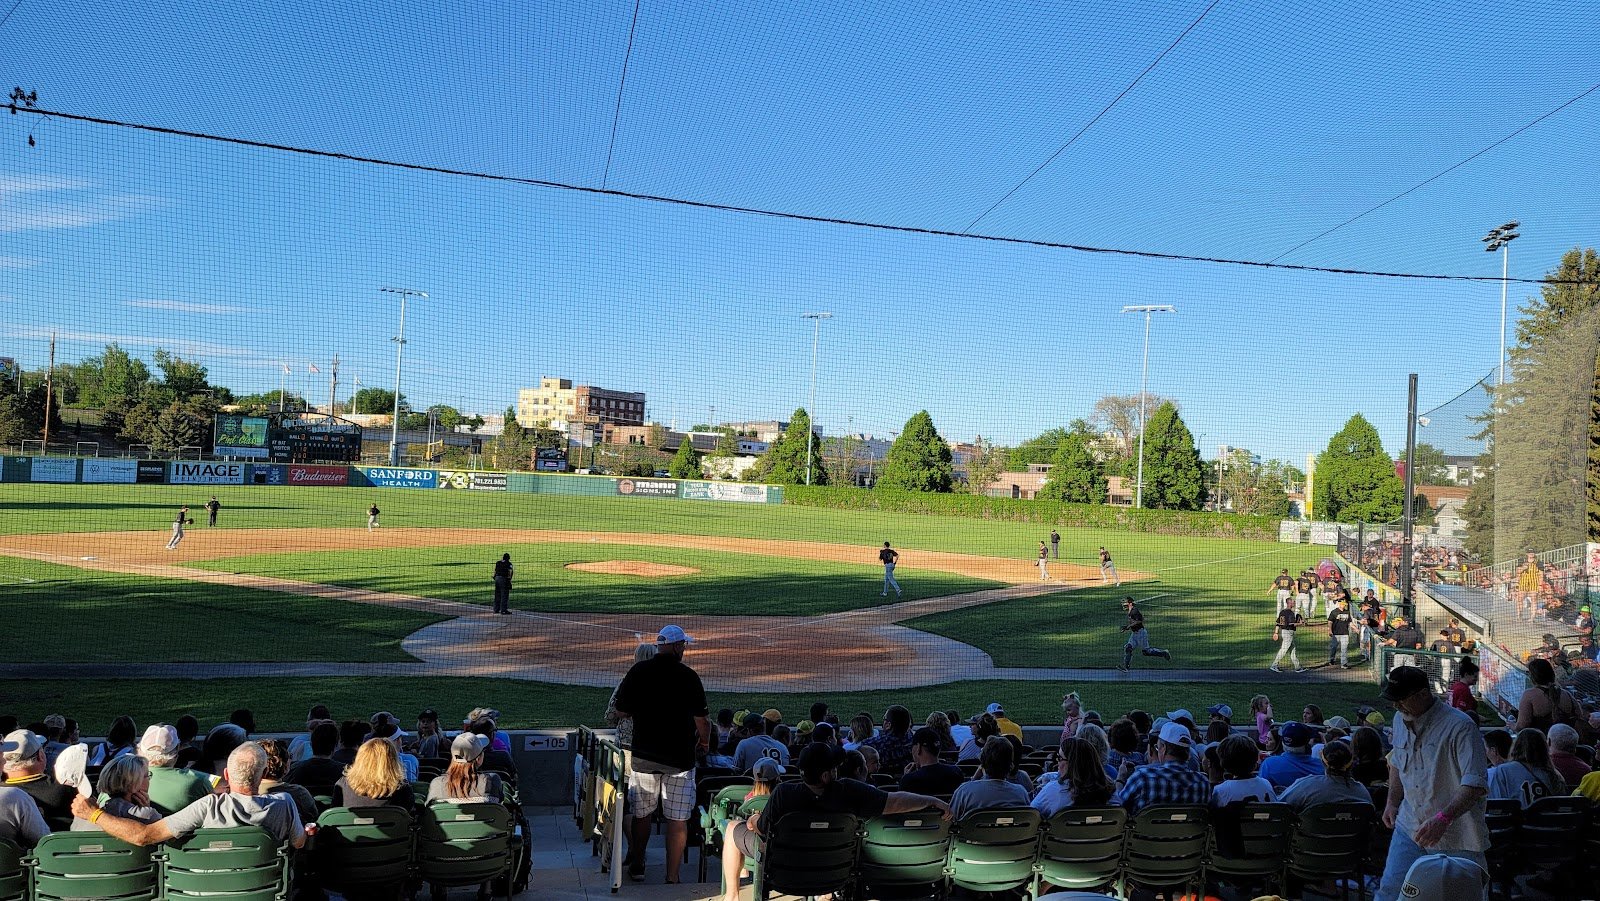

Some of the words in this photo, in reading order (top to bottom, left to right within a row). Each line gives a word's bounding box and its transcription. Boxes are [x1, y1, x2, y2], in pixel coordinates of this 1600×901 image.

[175, 463, 240, 477] IMAGE
[290, 468, 346, 482] Budweiser
[370, 469, 433, 481] SANFORD
[635, 481, 677, 489] mann
[544, 738, 565, 748] 105
